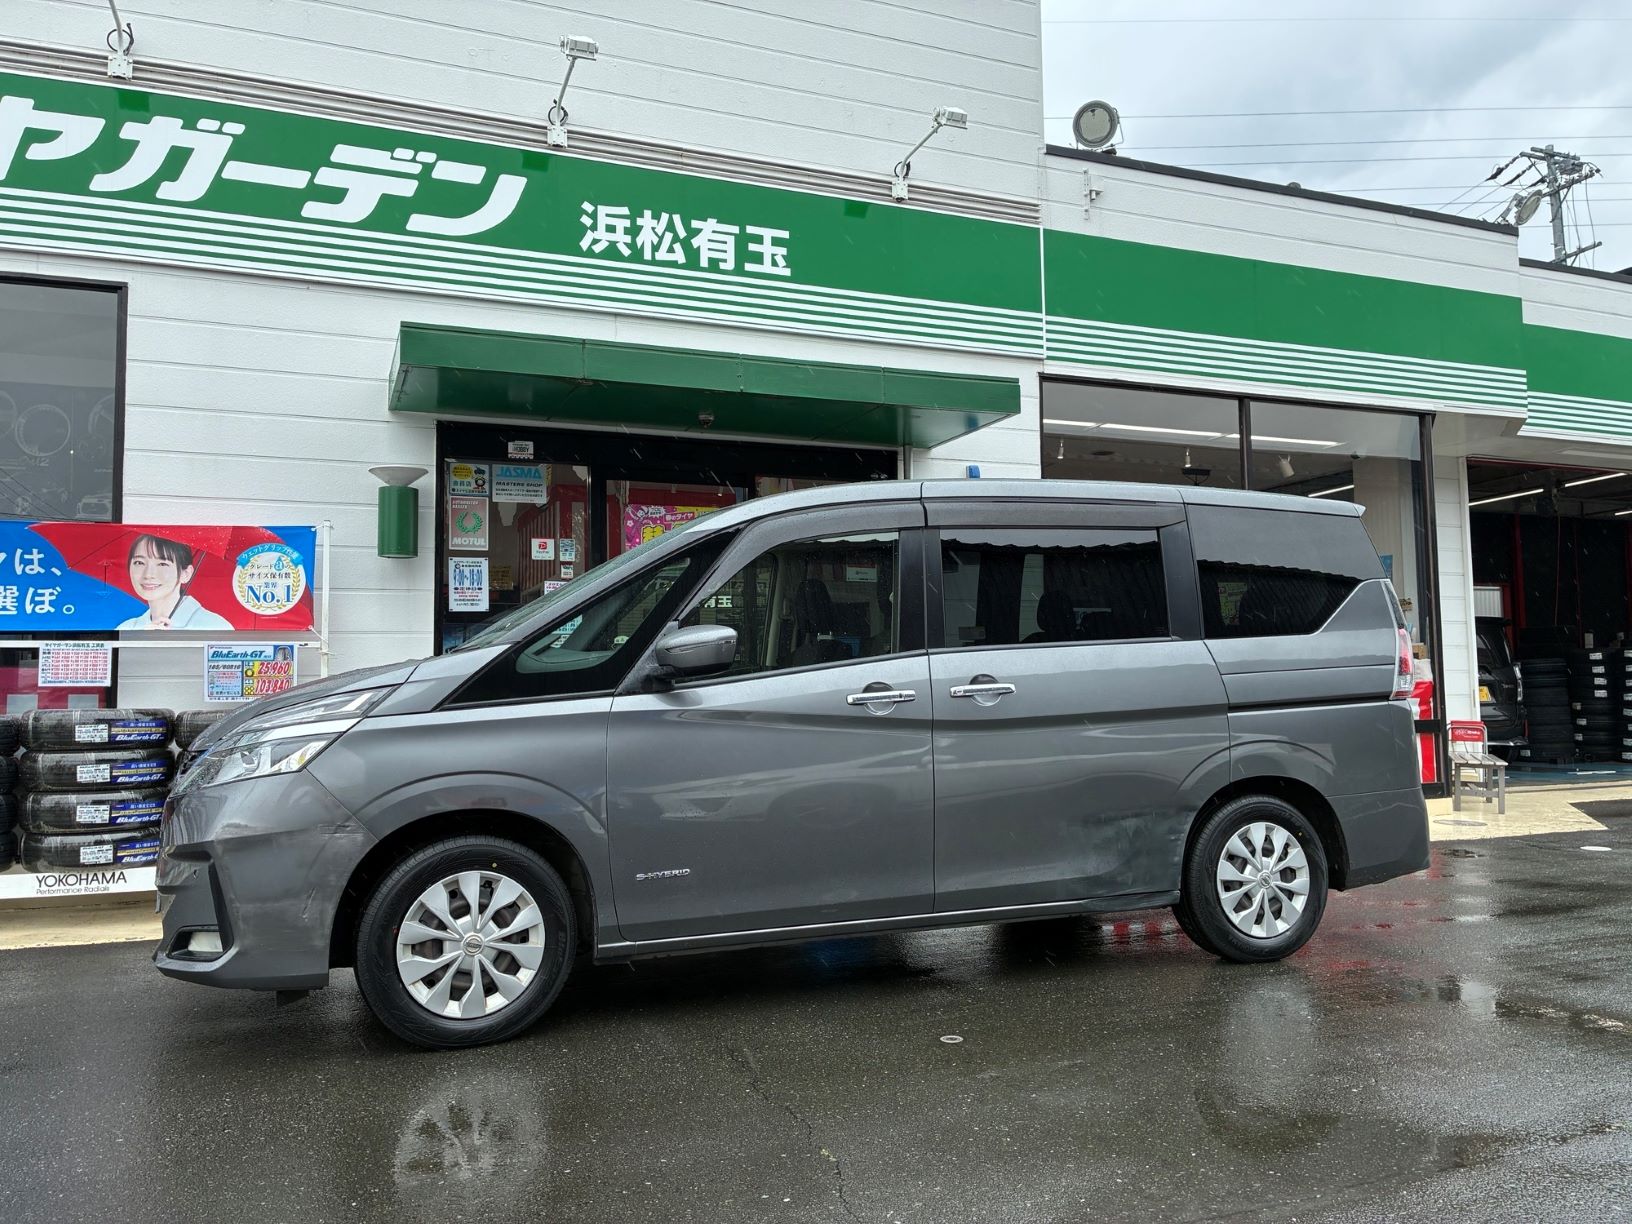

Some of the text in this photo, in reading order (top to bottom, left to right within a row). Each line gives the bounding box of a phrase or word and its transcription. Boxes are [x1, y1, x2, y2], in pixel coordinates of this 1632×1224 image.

[578, 200, 792, 277] 浜松有玉
[496, 466, 542, 480] JASMA
[495, 480, 525, 488] MASTERS
[452, 537, 486, 546] MOTUL
[0, 548, 62, 576] は、
[244, 584, 293, 604] No.1
[210, 650, 265, 659] BluEarth-GT
[115, 733, 161, 741] BluEarth-GT
[117, 773, 162, 783] BluEarth-GT
[116, 814, 161, 824] BluEarth-GT
[36, 871, 127, 888] YOKOHAMA
[636, 868, 691, 881] S-HYBRID
[84, 885, 110, 893] Radials
